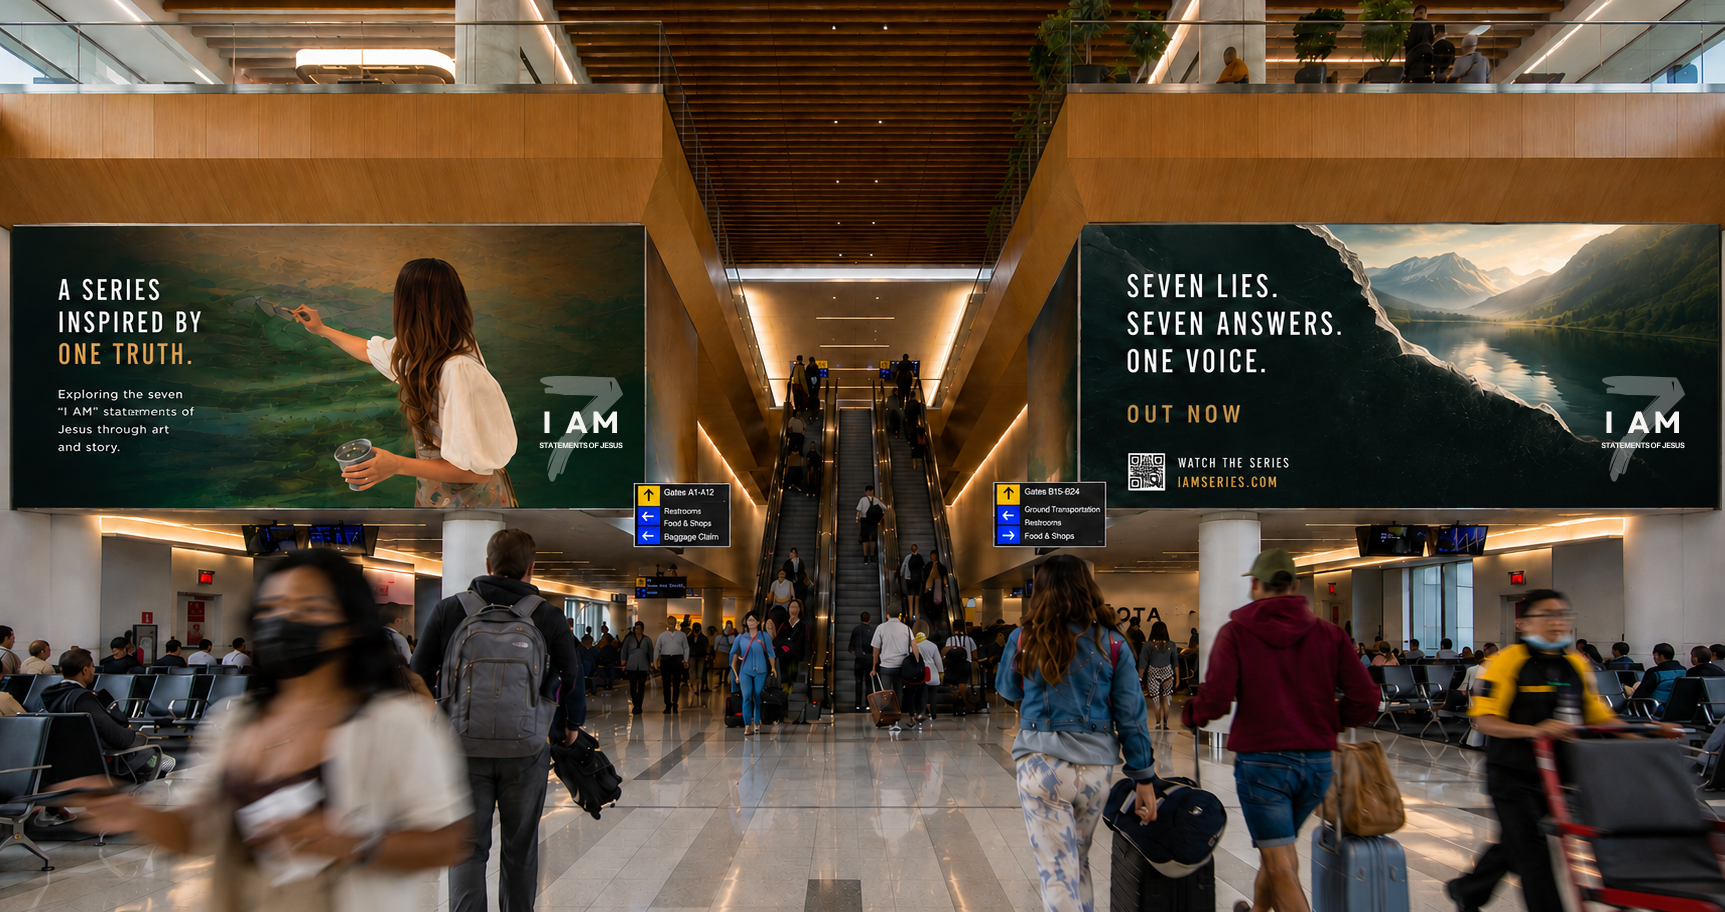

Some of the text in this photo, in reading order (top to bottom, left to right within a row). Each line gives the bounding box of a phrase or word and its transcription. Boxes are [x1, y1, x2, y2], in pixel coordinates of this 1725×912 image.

[58, 279, 160, 301] A SERIES
[1127, 274, 1278, 298] SEVEN LIES.
[59, 310, 202, 333] INSPIRED BY
[1127, 311, 1342, 336] SEVEN ANSWERS.
[58, 342, 192, 365] ONE TRUTH.
[1127, 349, 1266, 374] ONE VOICE.
[58, 389, 183, 401] Exploring the seven
[181, 406, 195, 417] of
[1127, 404, 1241, 424] OUT NOW
[544, 411, 618, 434] I AM
[1606, 411, 1680, 434] I AM
[58, 424, 170, 436] Jesus through art
[57, 442, 120, 454] and story.
[1178, 457, 1290, 468] WATCH THE SERIES
[1177, 476, 1277, 488] IAMSERIES.COM
[663, 488, 715, 496] Gates A1-A12
[1024, 487, 1047, 496] Gates
[663, 507, 702, 515] Restrooms
[1024, 505, 1101, 514] Ground Transportation
[663, 519, 712, 528] Food & Shops
[1024, 518, 1062, 526] Restrooms
[663, 533, 720, 543] Baggage Claim
[1024, 532, 1075, 541] Food & Shops
[1105, 604, 1161, 622] OTA
